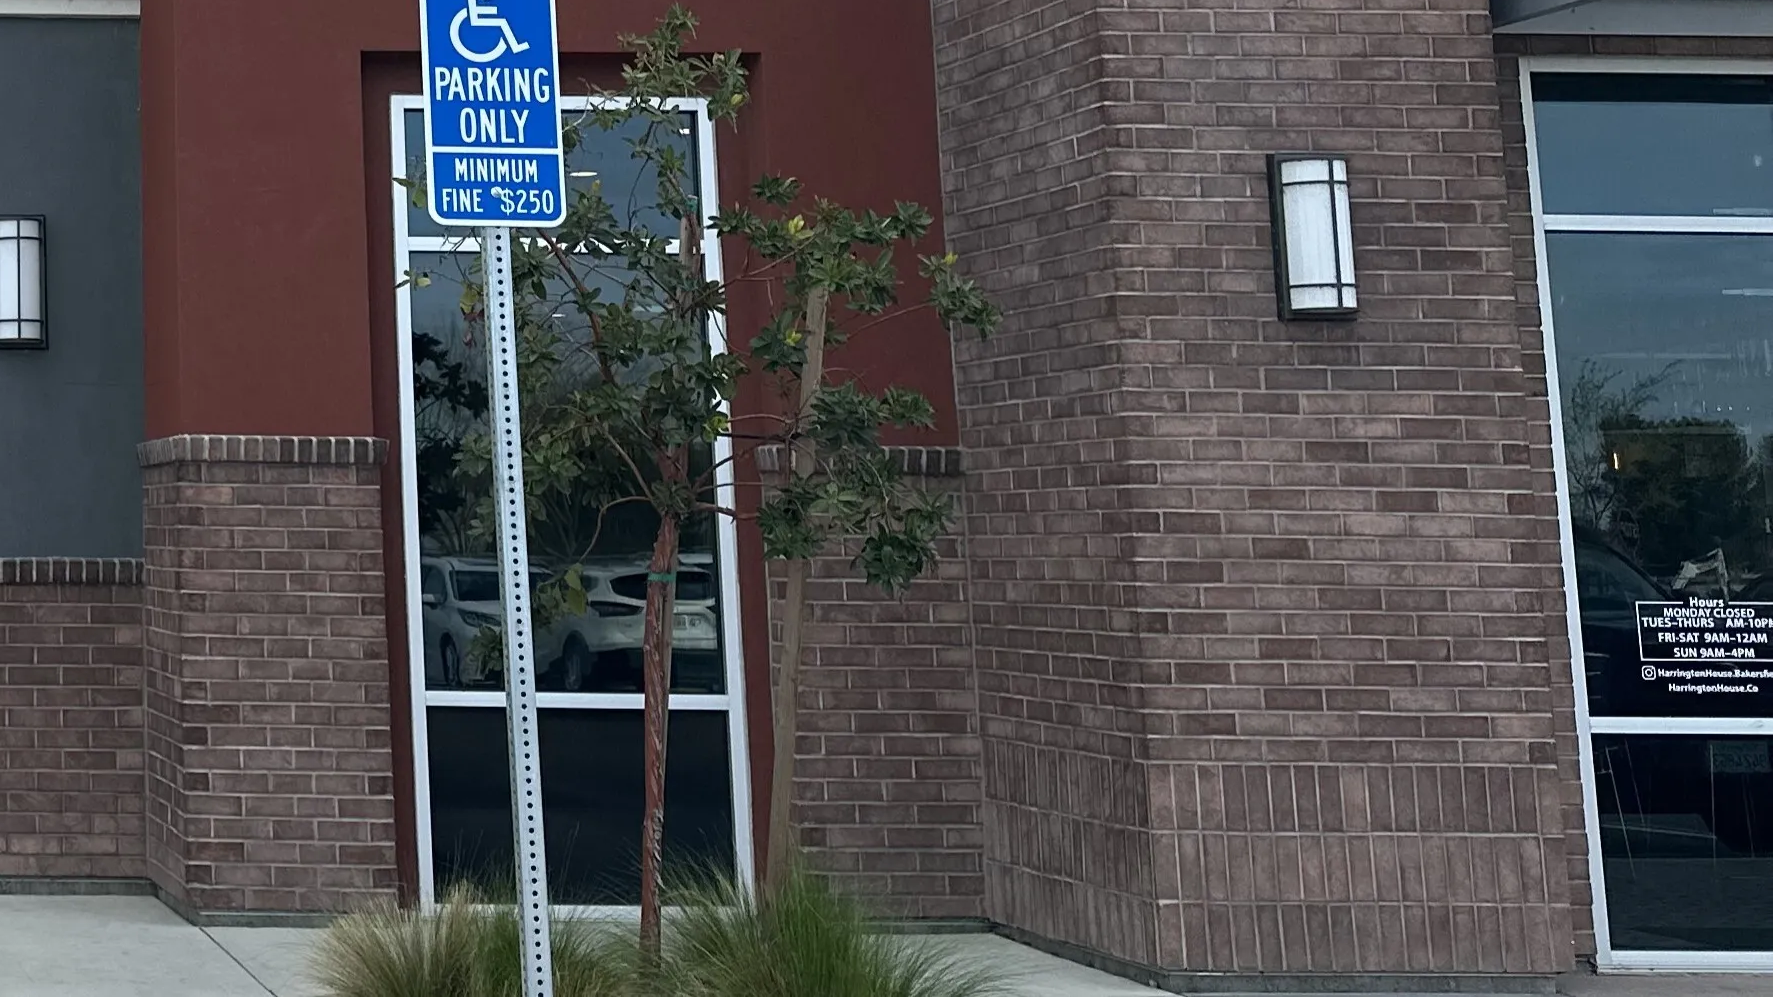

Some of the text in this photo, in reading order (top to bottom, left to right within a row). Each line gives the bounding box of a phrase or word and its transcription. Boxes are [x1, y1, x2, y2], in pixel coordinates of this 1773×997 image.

[435, 67, 550, 103] PARKING
[460, 108, 529, 143] ONLY
[455, 158, 538, 183] MINIMUM
[442, 188, 554, 215] FINE $250
[1689, 597, 1724, 607] Hours
[1663, 608, 1755, 618] MONDAY CLOSED
[1658, 633, 1700, 643] FRI-SAT
[1674, 648, 1697, 658] SUN
